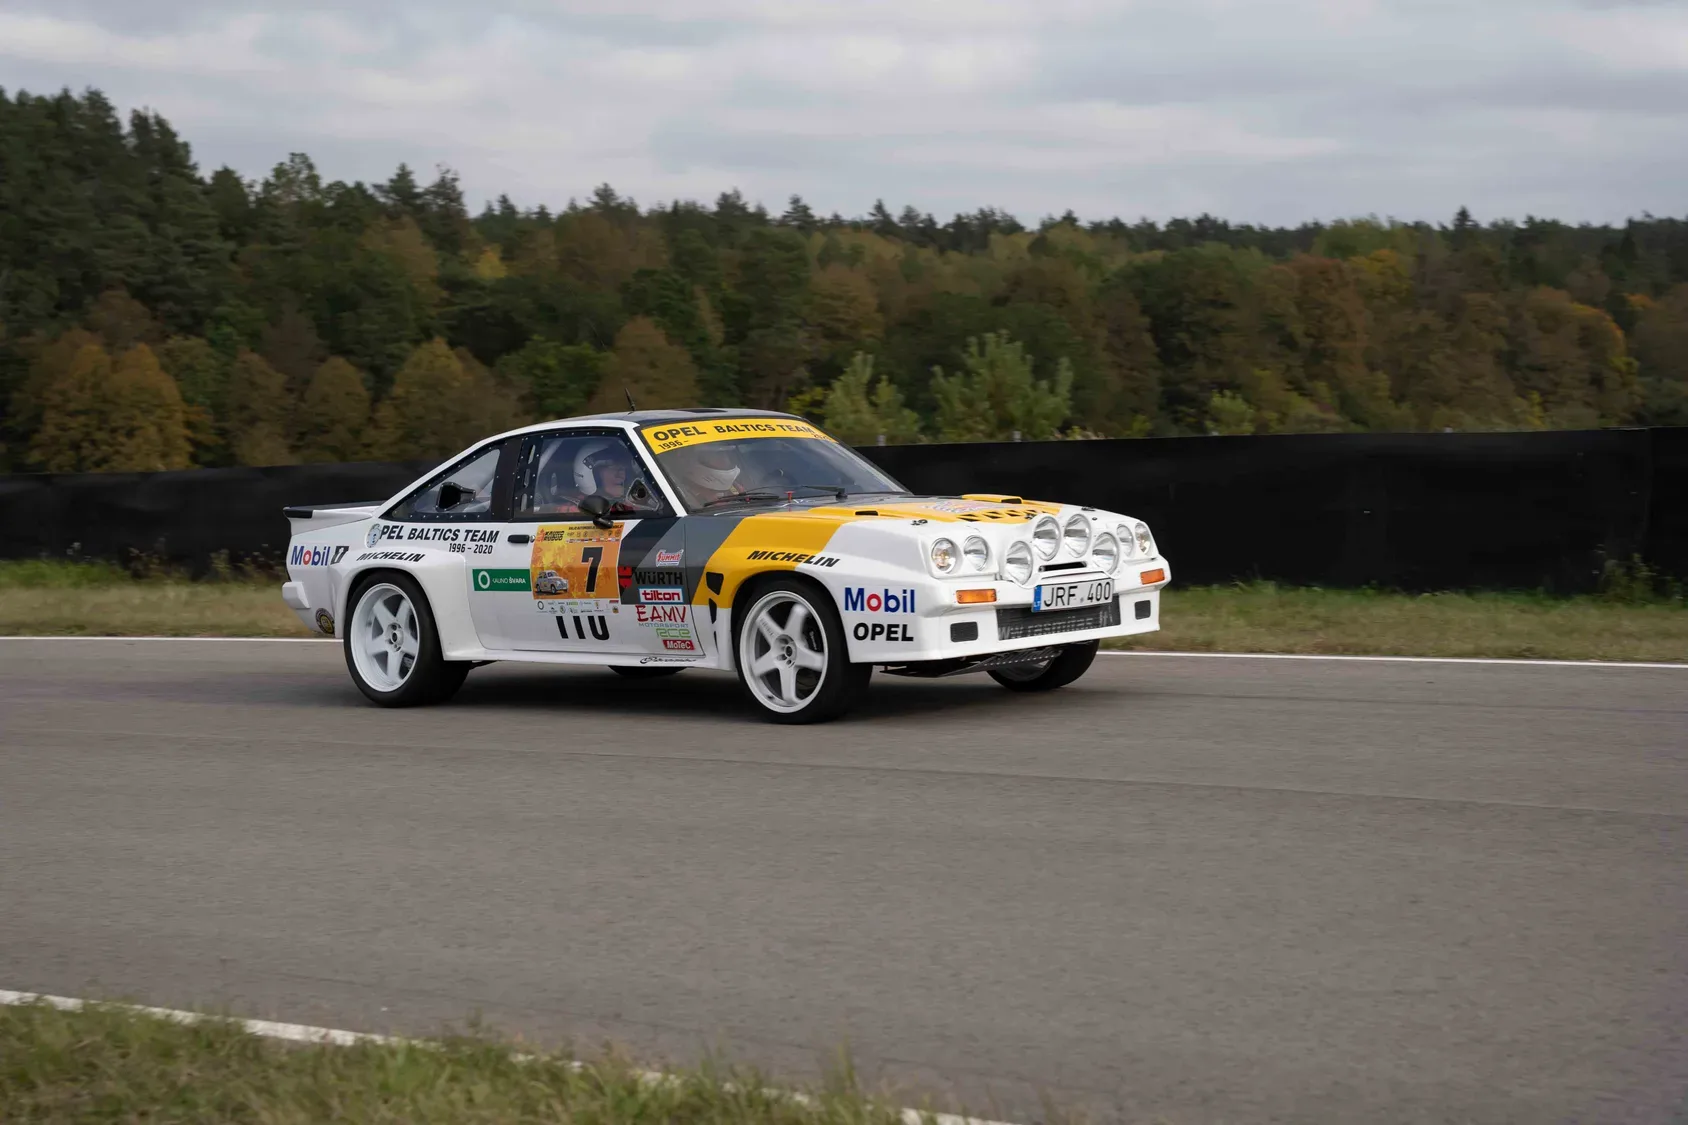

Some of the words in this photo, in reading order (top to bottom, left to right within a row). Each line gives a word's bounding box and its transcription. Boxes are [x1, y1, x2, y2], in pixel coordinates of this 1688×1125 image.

[653, 426, 707, 441] OPEL
[714, 424, 775, 433] BALTICS
[777, 424, 814, 434] TEAM
[658, 440, 683, 450] 1996
[407, 528, 460, 541] BALTICS
[464, 530, 500, 543] TEAM
[291, 545, 331, 566] Mobil
[449, 543, 466, 553] 1996
[473, 544, 493, 554] 2020
[356, 552, 425, 562] MICHELIN
[747, 550, 840, 567] MICHELIN
[581, 546, 603, 592] 7
[509, 576, 526, 584] ŠVARA
[635, 571, 683, 585] WÜRTH
[642, 590, 680, 601] tilton
[844, 588, 915, 613] Mobil
[1044, 586, 1078, 607] JRF
[1087, 582, 1111, 602] 400
[635, 604, 686, 622] EAMV
[853, 623, 914, 642] OPEL
[666, 640, 691, 649] MoTeC
